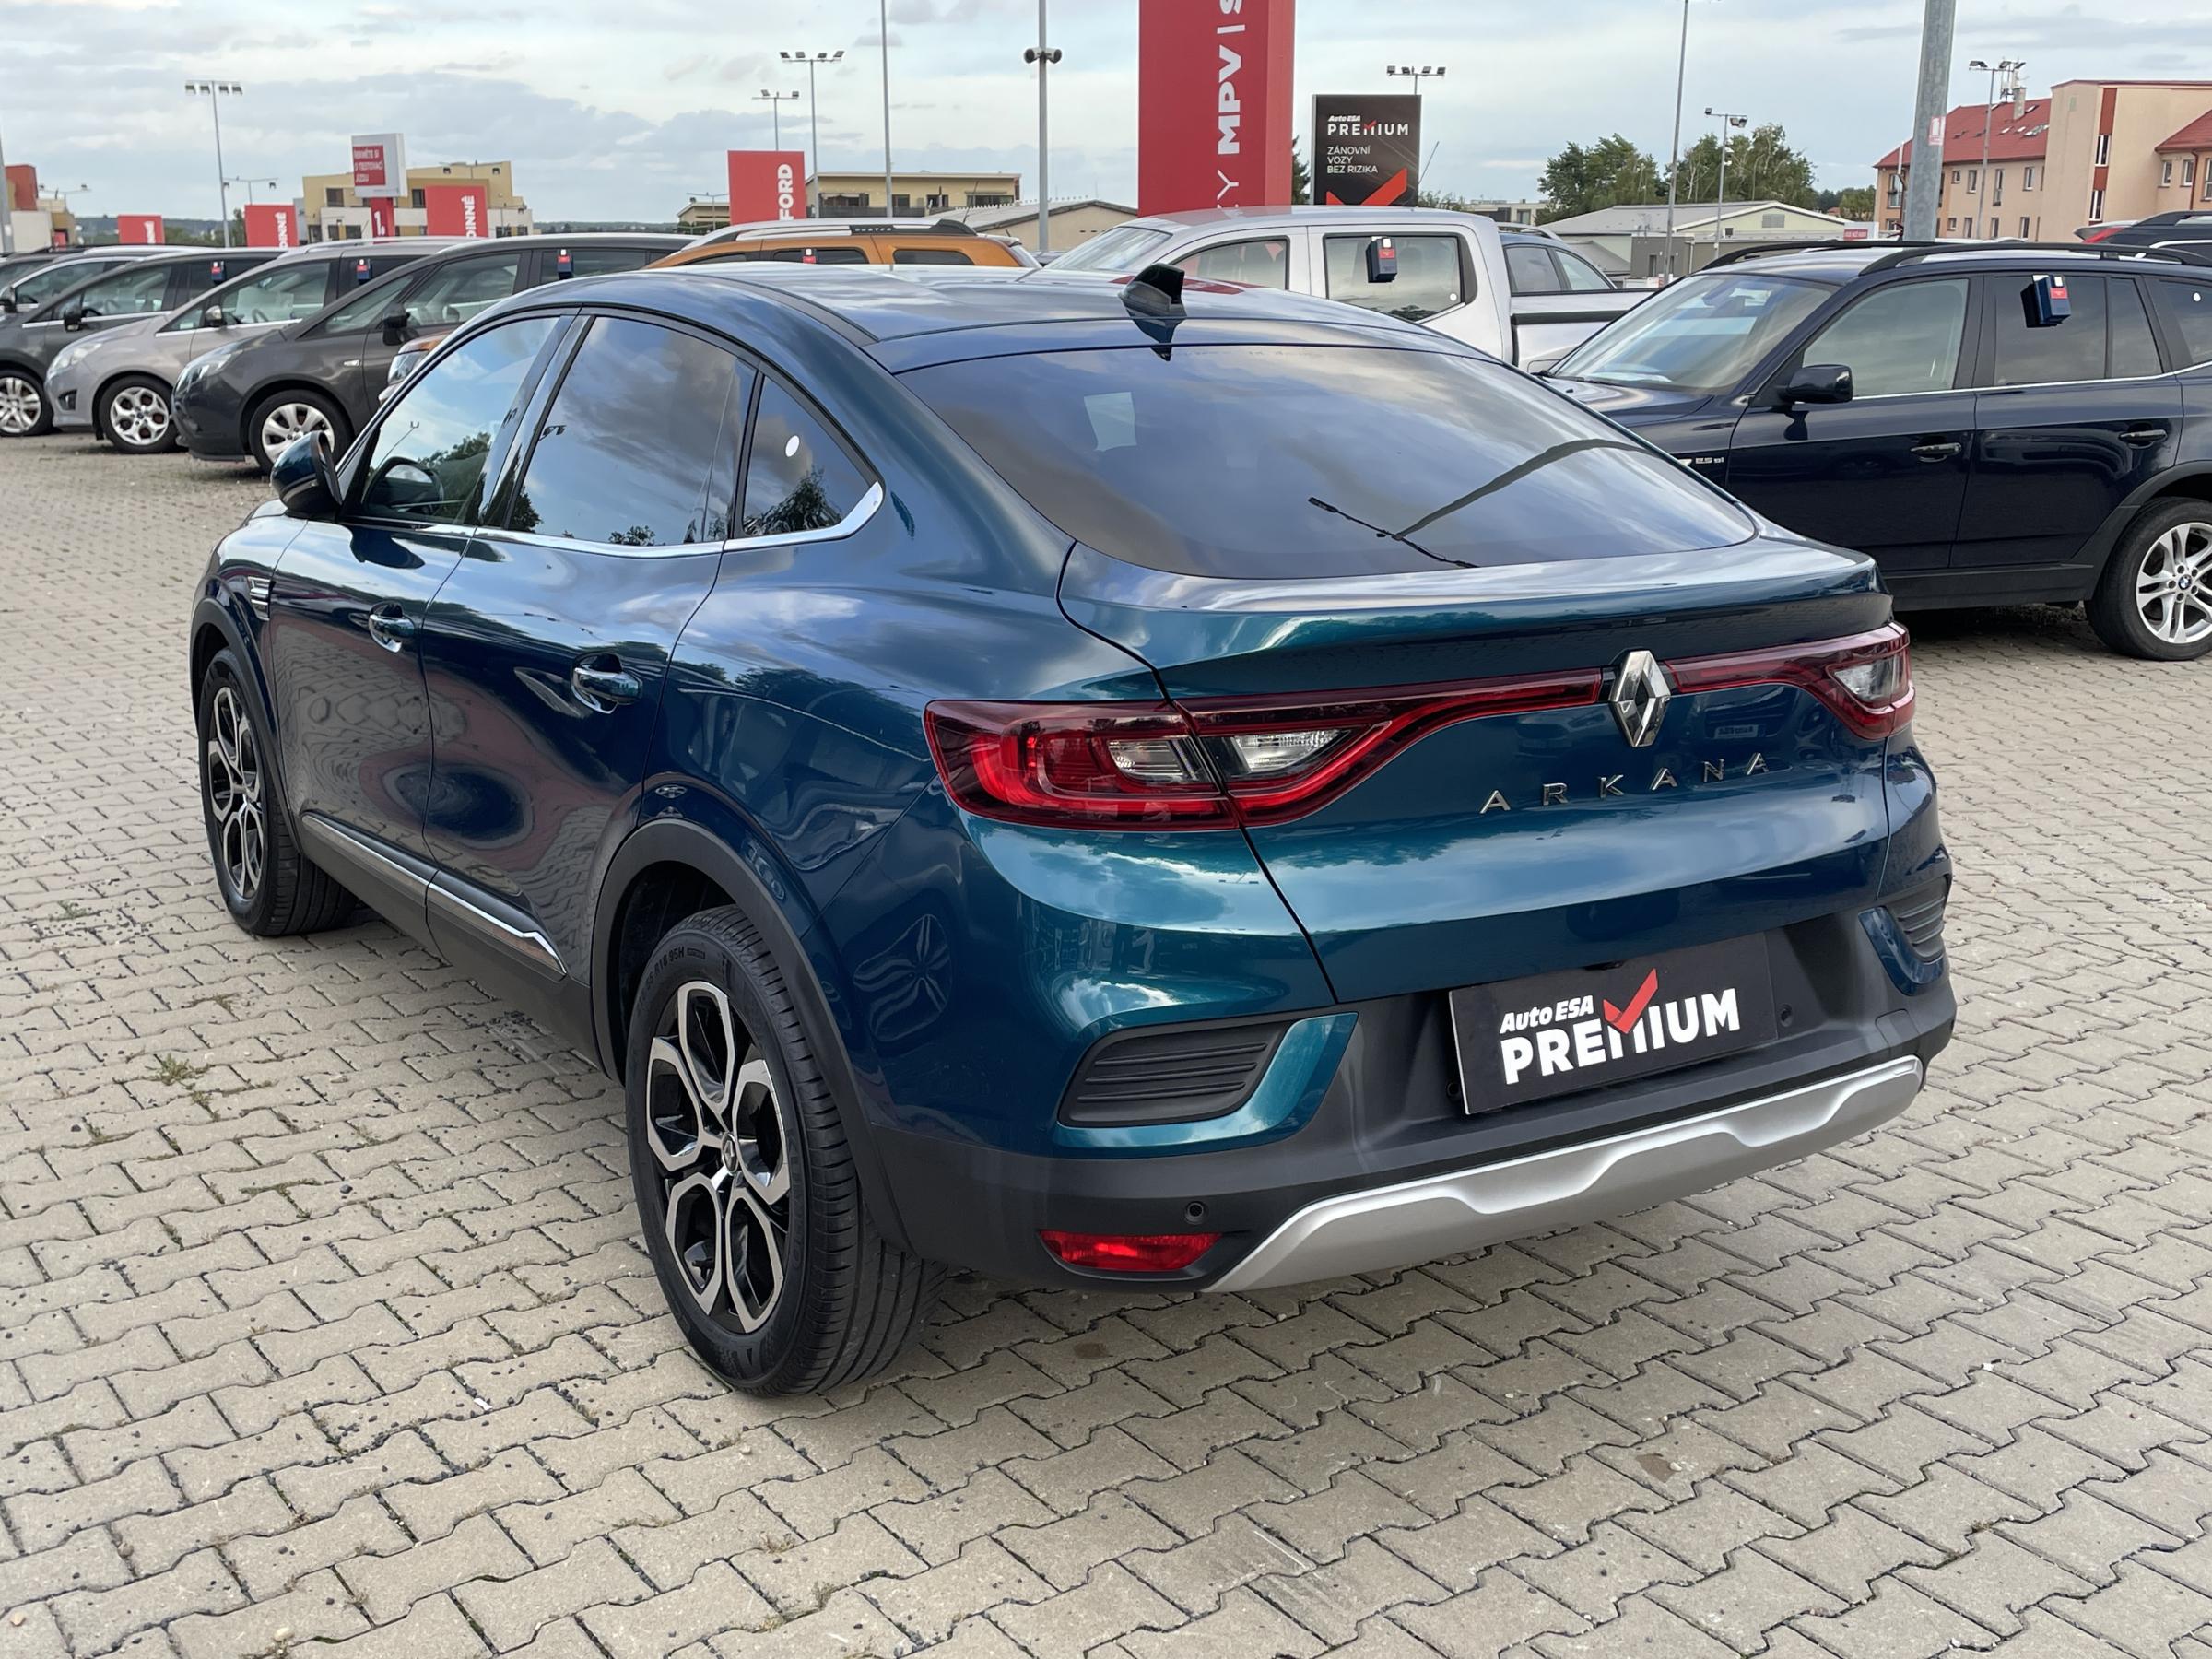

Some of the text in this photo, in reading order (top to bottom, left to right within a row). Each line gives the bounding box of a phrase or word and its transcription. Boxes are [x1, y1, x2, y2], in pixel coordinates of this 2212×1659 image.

[1218, 44, 1241, 155] MPV
[1327, 124, 1409, 135] PREMIUM
[1327, 145, 1371, 155] ZÁNOVNÍ
[1327, 156, 1353, 164] VOZY
[1327, 165, 1378, 173] BEZ RIZIKA
[777, 164, 794, 220] FORD
[1217, 169, 1240, 208] Y
[1479, 752, 1770, 814] ARKANA
[1500, 995, 1594, 1034] Auto ESA
[1500, 988, 1740, 1085] PREMIUM
